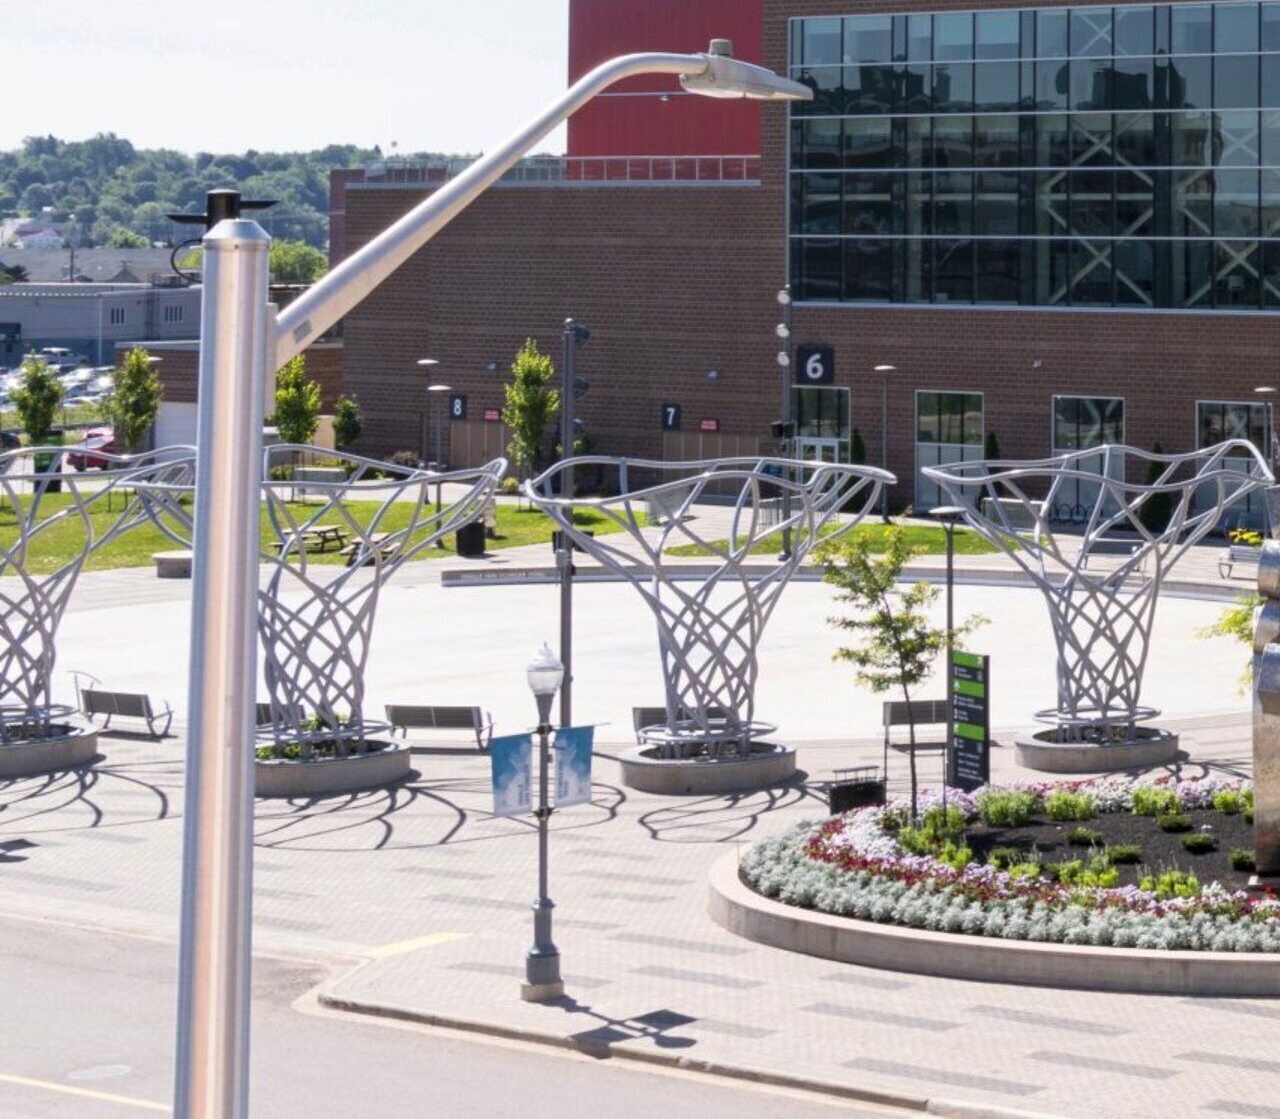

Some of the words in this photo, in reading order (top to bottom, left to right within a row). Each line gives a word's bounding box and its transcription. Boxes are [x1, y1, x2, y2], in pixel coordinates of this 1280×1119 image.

[806, 352, 824, 380] 6
[453, 397, 462, 417] 8
[666, 406, 676, 427] 7
